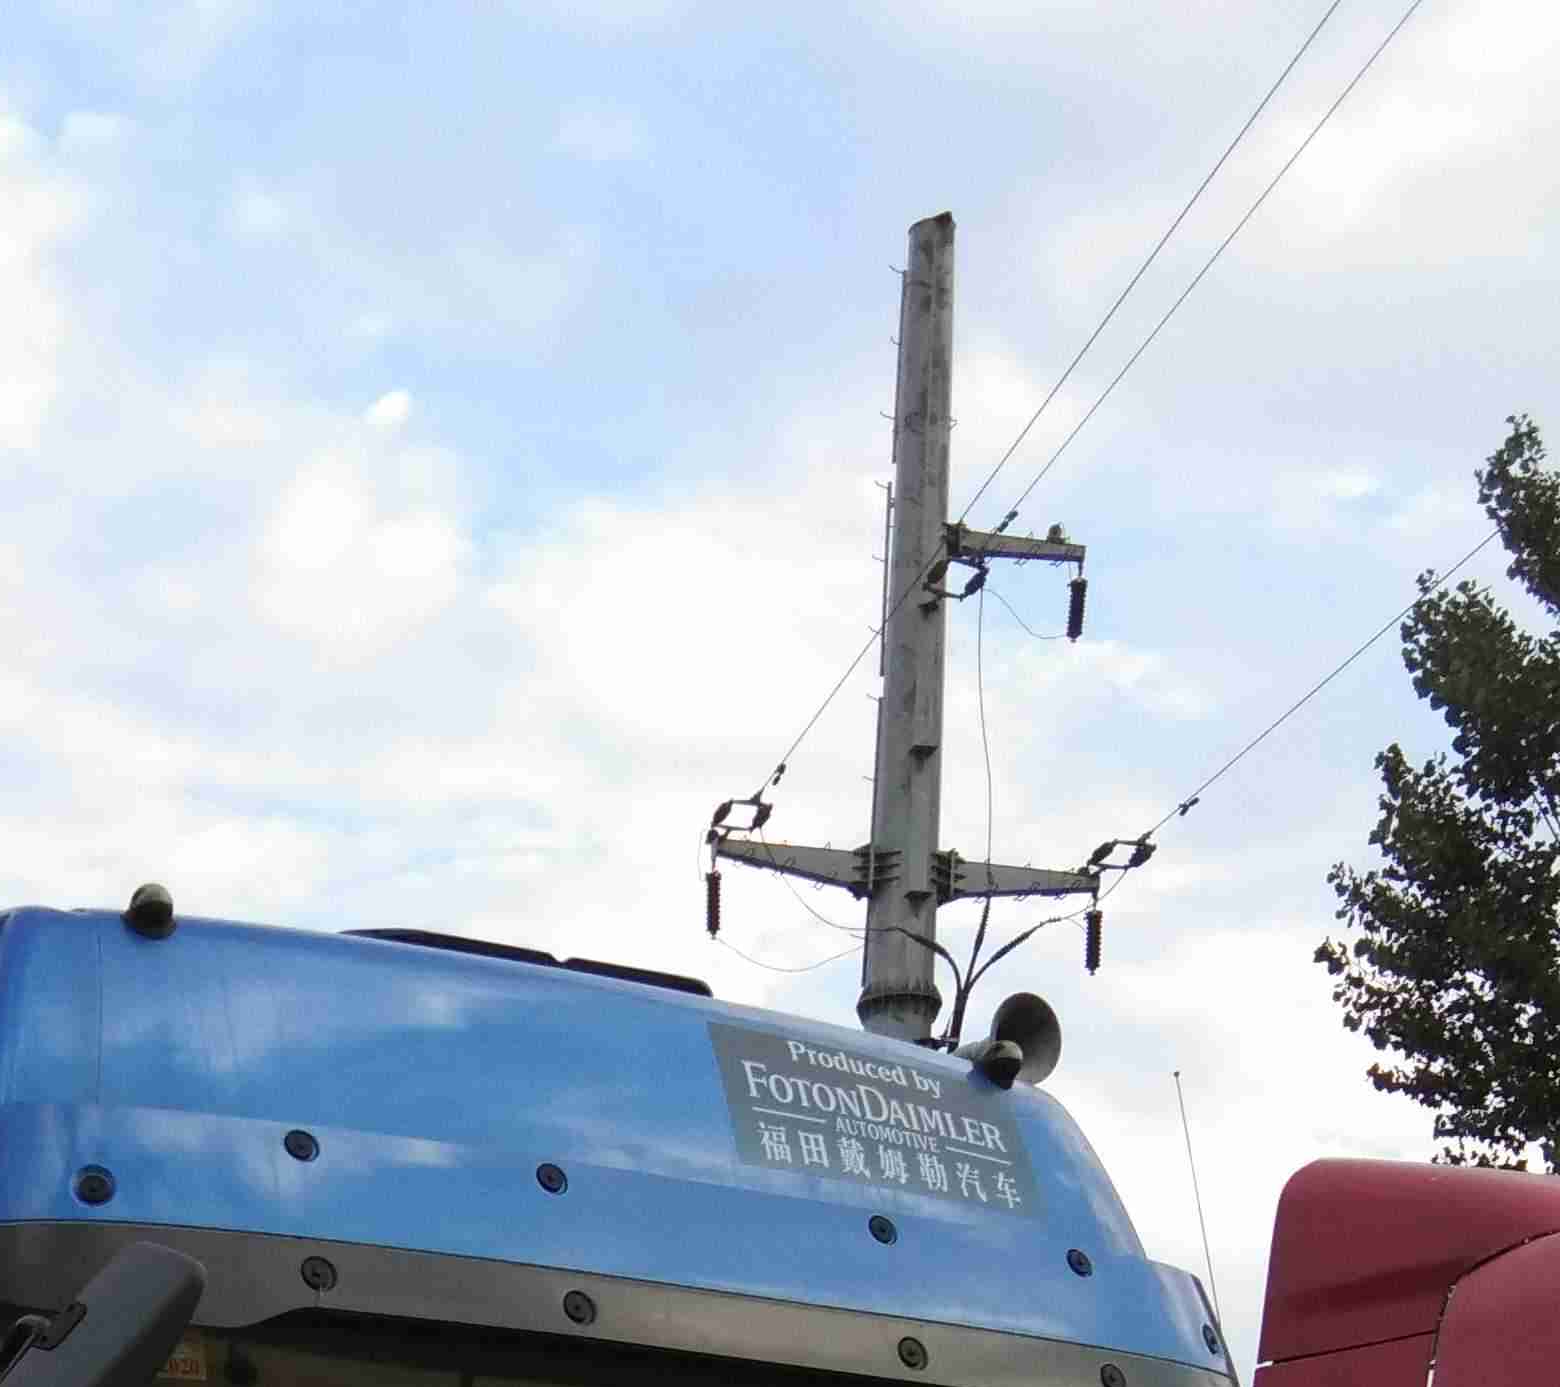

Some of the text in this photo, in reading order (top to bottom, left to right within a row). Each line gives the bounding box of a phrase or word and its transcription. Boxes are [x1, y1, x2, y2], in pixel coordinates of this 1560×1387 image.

[786, 1040, 941, 1099] Produced by
[834, 1117, 940, 1153] AUTOMOTIVE
[758, 1121, 1022, 1209] 福田戴姆勒汽车
